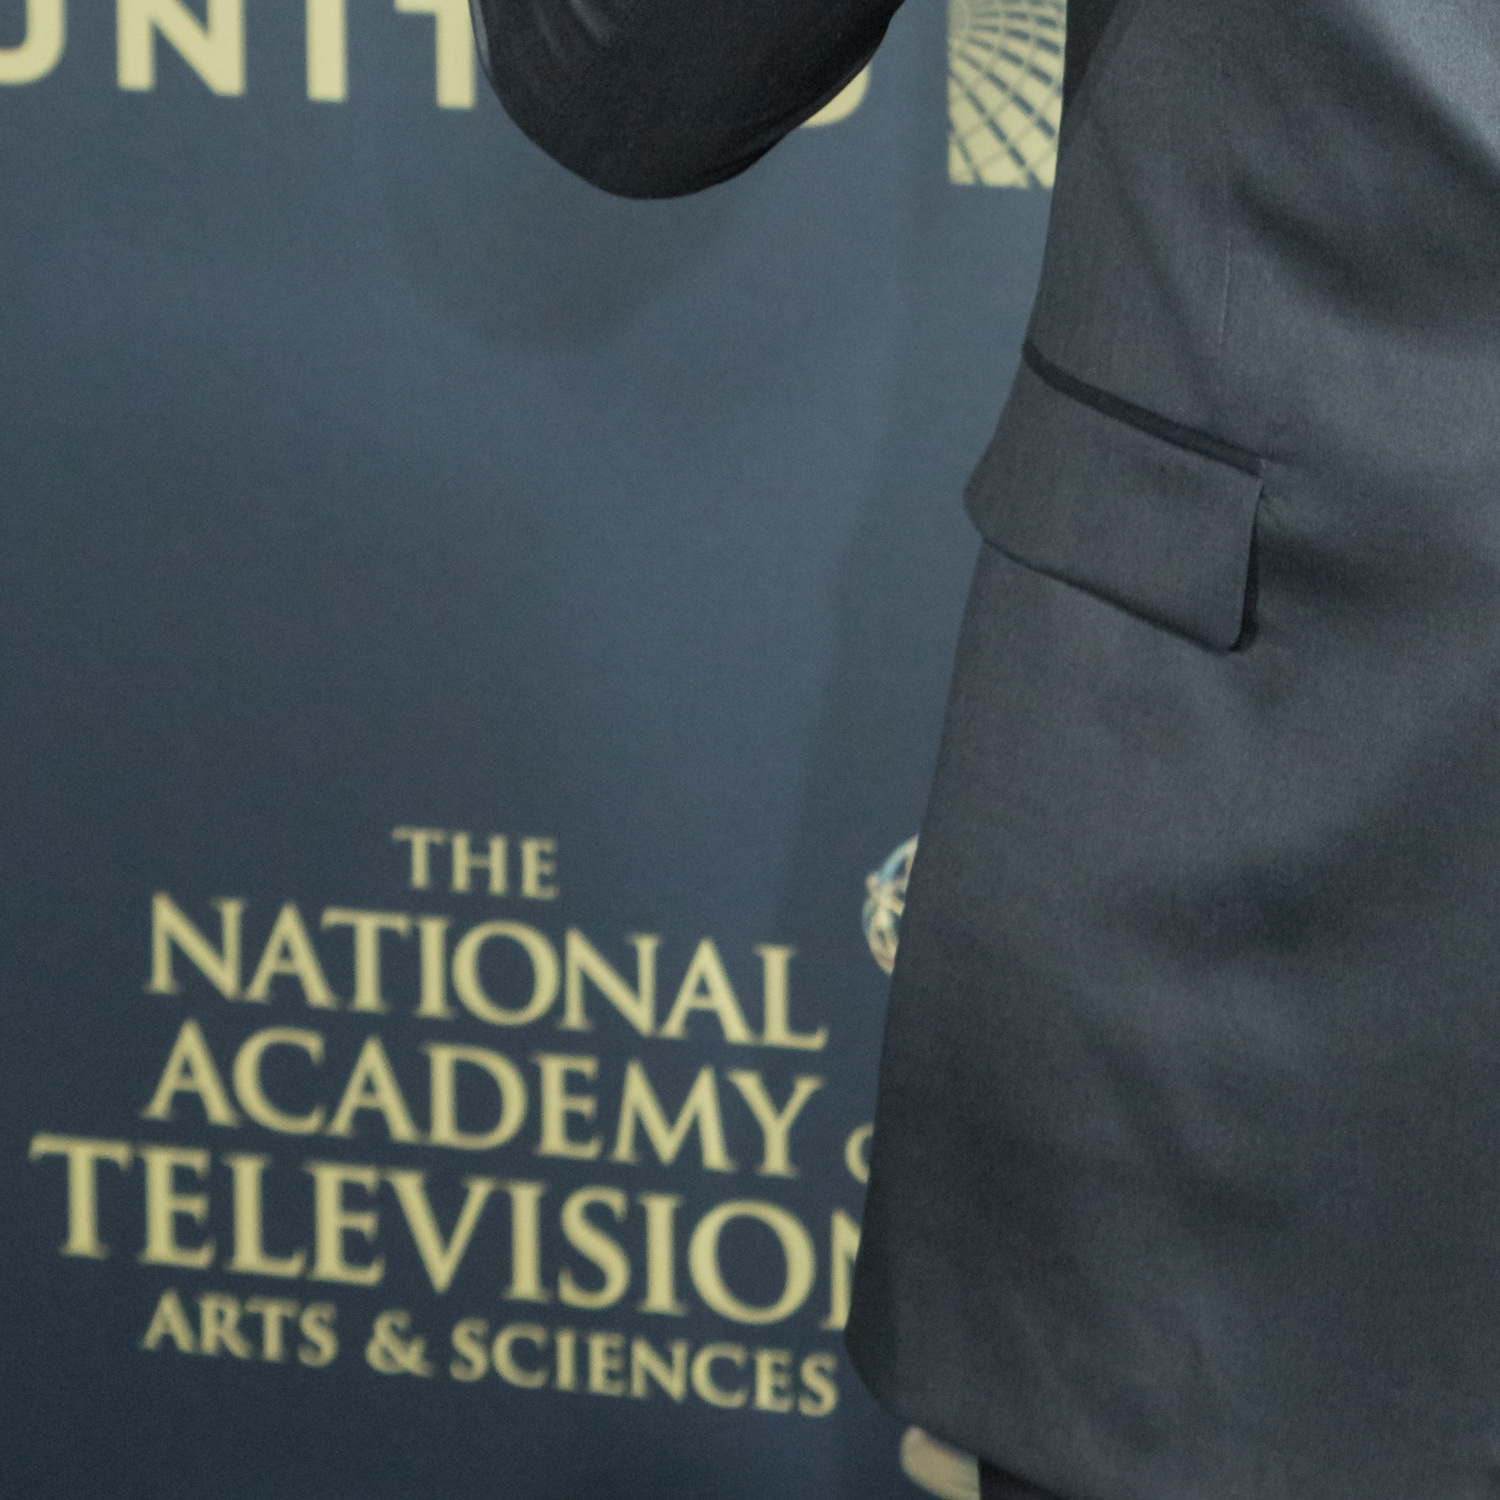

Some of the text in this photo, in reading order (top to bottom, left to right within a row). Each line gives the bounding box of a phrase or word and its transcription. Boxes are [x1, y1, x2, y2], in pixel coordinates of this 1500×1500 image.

[392, 826, 558, 899] THE
[145, 892, 828, 1051] NATIONAL
[141, 1019, 824, 1178] ACADEMY
[140, 1289, 838, 1417] ARTS & SCIENCES
